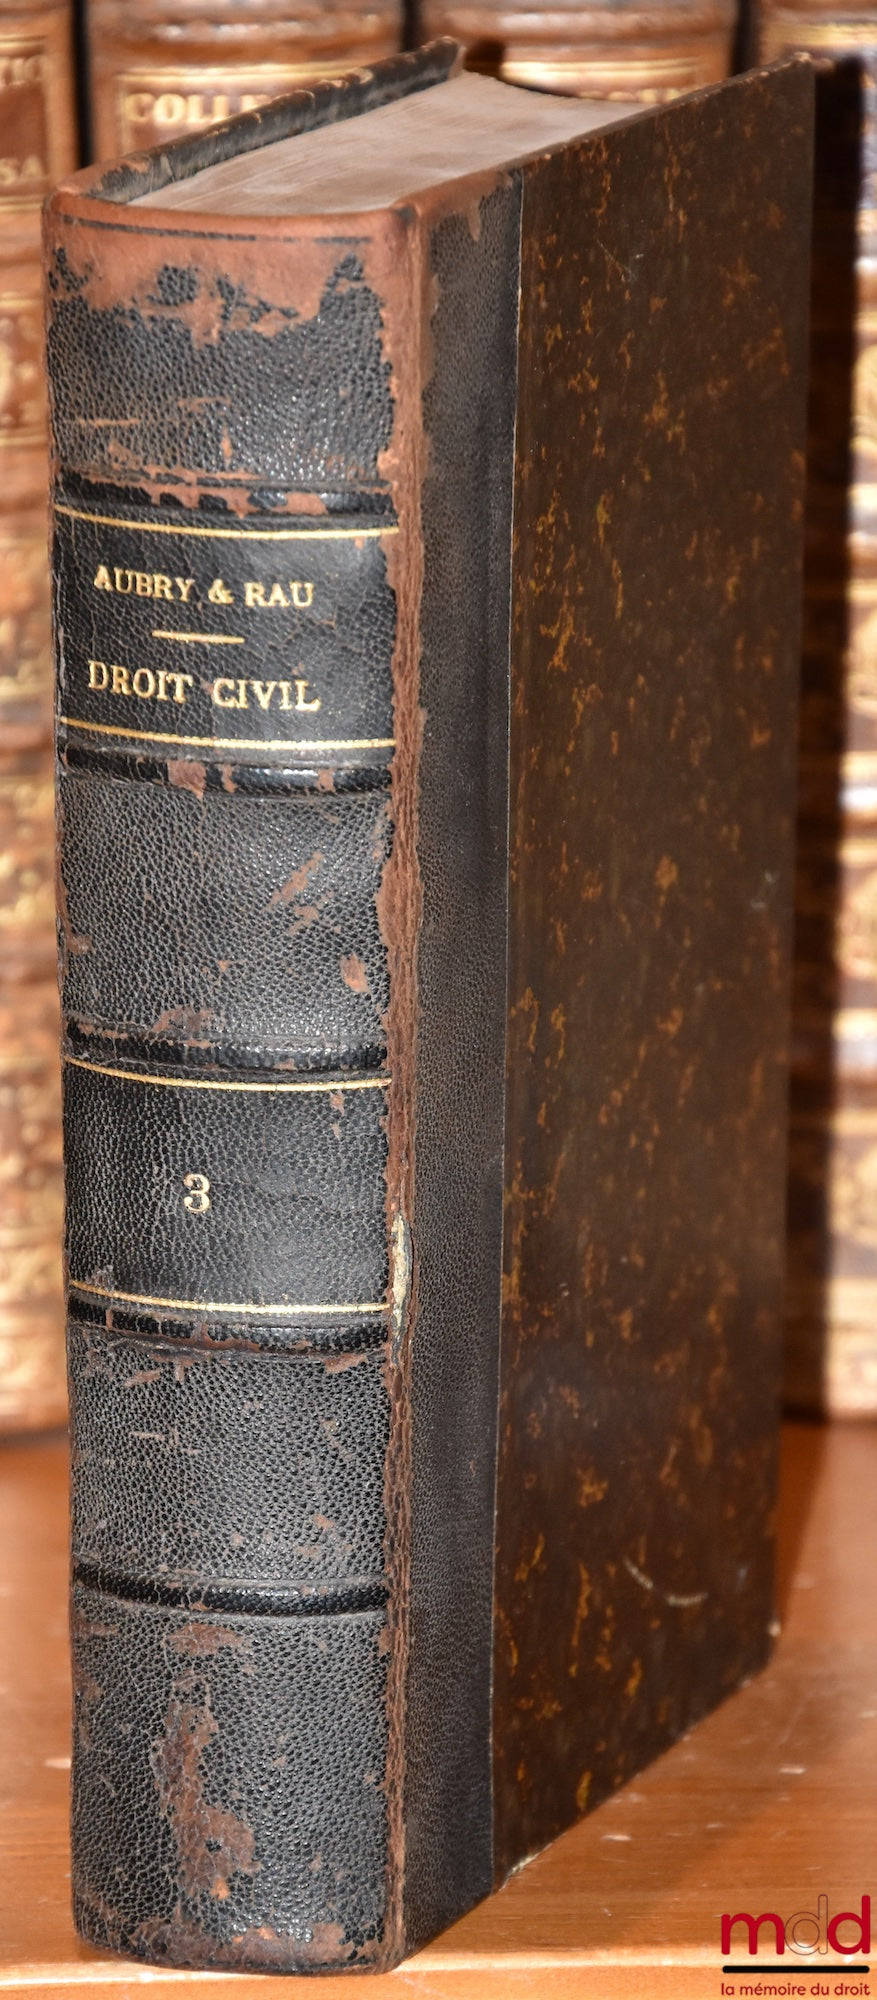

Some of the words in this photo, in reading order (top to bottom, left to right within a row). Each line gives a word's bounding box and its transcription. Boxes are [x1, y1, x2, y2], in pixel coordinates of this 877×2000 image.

[94, 565, 195, 602] AUBRY
[208, 579, 234, 604] &
[244, 581, 314, 607] RAU
[88, 660, 193, 703] DROIT
[212, 680, 321, 711] CIVIL
[183, 1173, 210, 1213] 3
